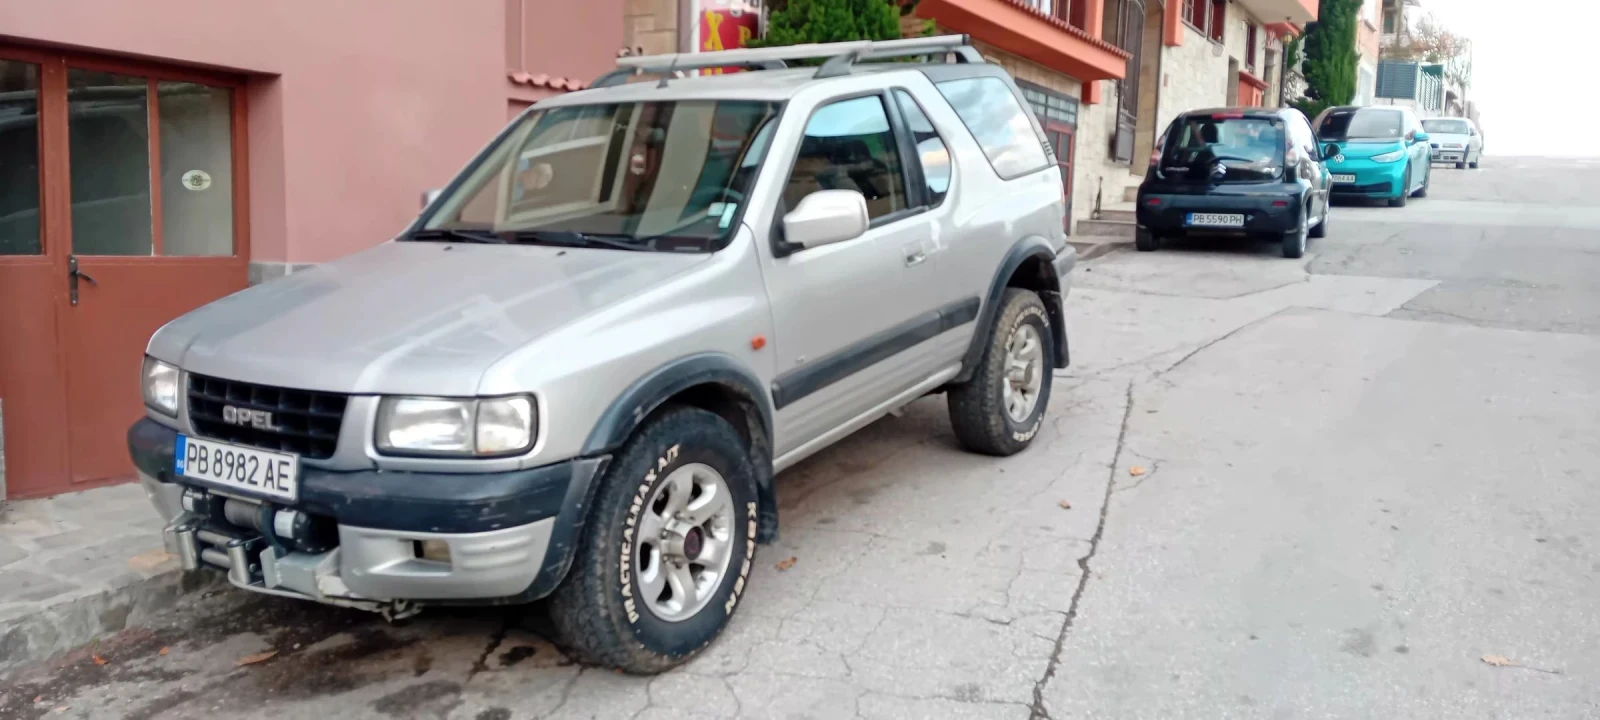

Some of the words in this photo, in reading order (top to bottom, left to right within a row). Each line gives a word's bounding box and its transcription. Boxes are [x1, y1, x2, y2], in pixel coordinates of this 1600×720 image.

[1193, 214, 1205, 224] PB
[1206, 214, 1229, 224] 5590
[1230, 215, 1242, 225] PH
[222, 404, 279, 432] OPEL
[186, 442, 209, 474] PB
[212, 448, 260, 486] 8982
[263, 457, 291, 492] AE
